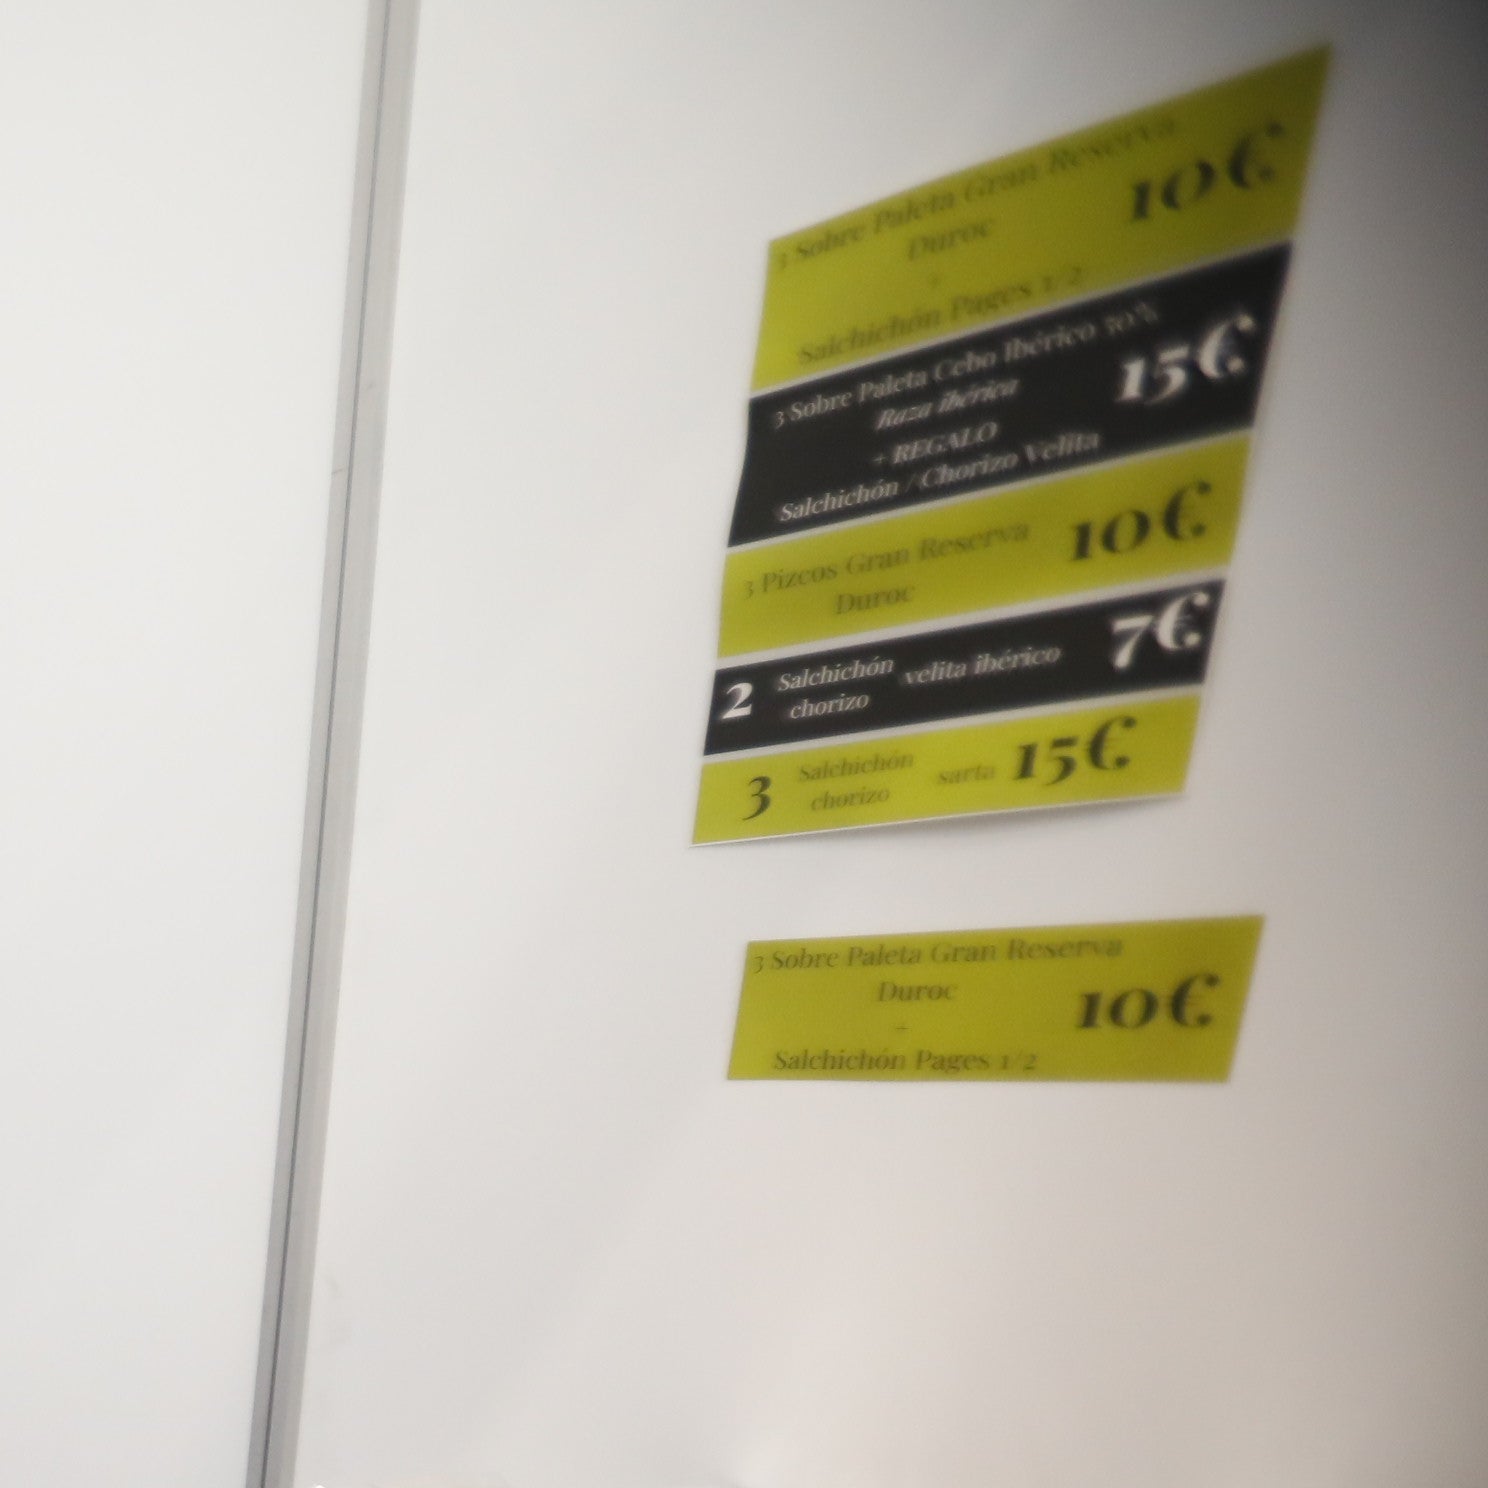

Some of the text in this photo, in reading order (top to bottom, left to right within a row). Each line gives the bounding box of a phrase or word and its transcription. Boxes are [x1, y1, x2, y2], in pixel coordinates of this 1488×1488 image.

[1129, 120, 1286, 221] 10€
[1115, 314, 1255, 404] 15€
[789, 389, 853, 421] Sobre
[858, 369, 928, 403] Paleta
[934, 350, 996, 381] Cebo
[877, 401, 933, 430] Raza
[892, 420, 999, 466] REGALO
[778, 479, 899, 523] Salchichón
[1070, 480, 1212, 561] 10€
[761, 562, 837, 593] Pizcos
[845, 547, 910, 575] Gran
[919, 522, 1030, 562] Reserva
[835, 585, 915, 615] Duroc
[1110, 591, 1211, 669] 7€
[777, 656, 894, 692] Salchichón
[902, 645, 1062, 686] velita ibérico
[721, 682, 753, 720] 2
[789, 693, 870, 721] chorizo
[797, 750, 915, 783] Salchichón
[1012, 714, 1138, 787] 15€
[937, 763, 996, 785] sarta
[742, 775, 772, 822] 3
[810, 786, 891, 812] chorizo
[770, 947, 839, 970] Sobre
[847, 942, 922, 967] Paleta
[931, 941, 997, 965] Gran
[1007, 938, 1123, 961] Reserva
[878, 980, 958, 1002] Duroc
[1077, 972, 1221, 1029] 10€
[773, 1048, 906, 1071] Salchichón
